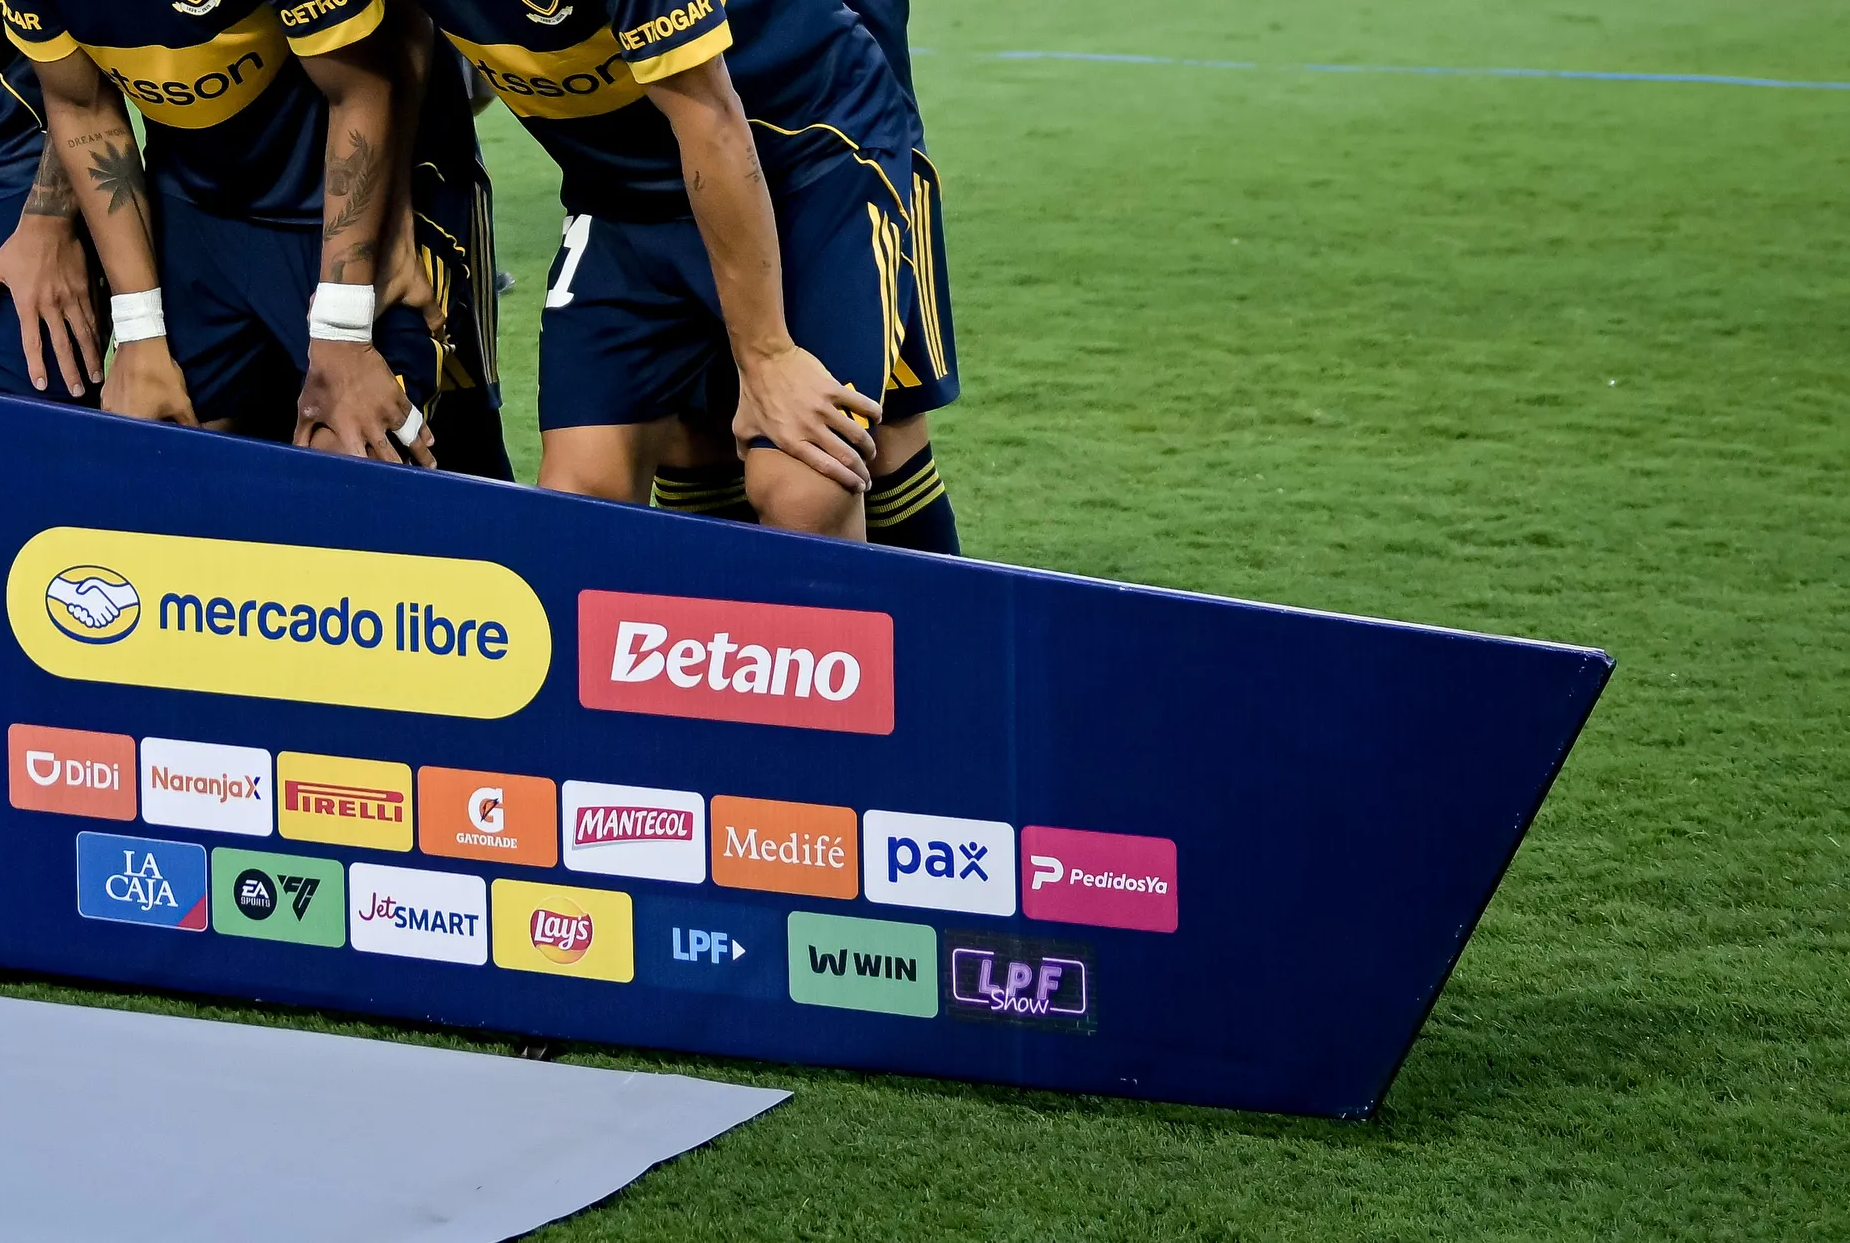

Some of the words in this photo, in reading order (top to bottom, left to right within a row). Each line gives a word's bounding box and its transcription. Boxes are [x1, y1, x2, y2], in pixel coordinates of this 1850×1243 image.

[102, 51, 265, 106] tsson
[159, 591, 383, 649] mercado
[395, 601, 509, 661] libre
[610, 620, 862, 702] Betano
[65, 759, 120, 791] DiDi
[284, 779, 405, 822] PIRELLI
[456, 832, 518, 849] GATORADE
[577, 807, 690, 840] MANTECOL
[122, 850, 164, 881] LA
[722, 825, 846, 870] Medifé
[887, 836, 989, 883] pax
[105, 874, 179, 911] CAJA
[241, 879, 270, 899] EA
[1069, 868, 1169, 896] PedidosYa
[240, 896, 271, 908] SPORTS
[358, 891, 480, 937] JetSMART
[532, 909, 590, 951] Lay's
[672, 927, 729, 964] LPF
[852, 951, 917, 983] WIN
[977, 958, 1063, 1002] LPF
[990, 988, 1050, 1015] Show
